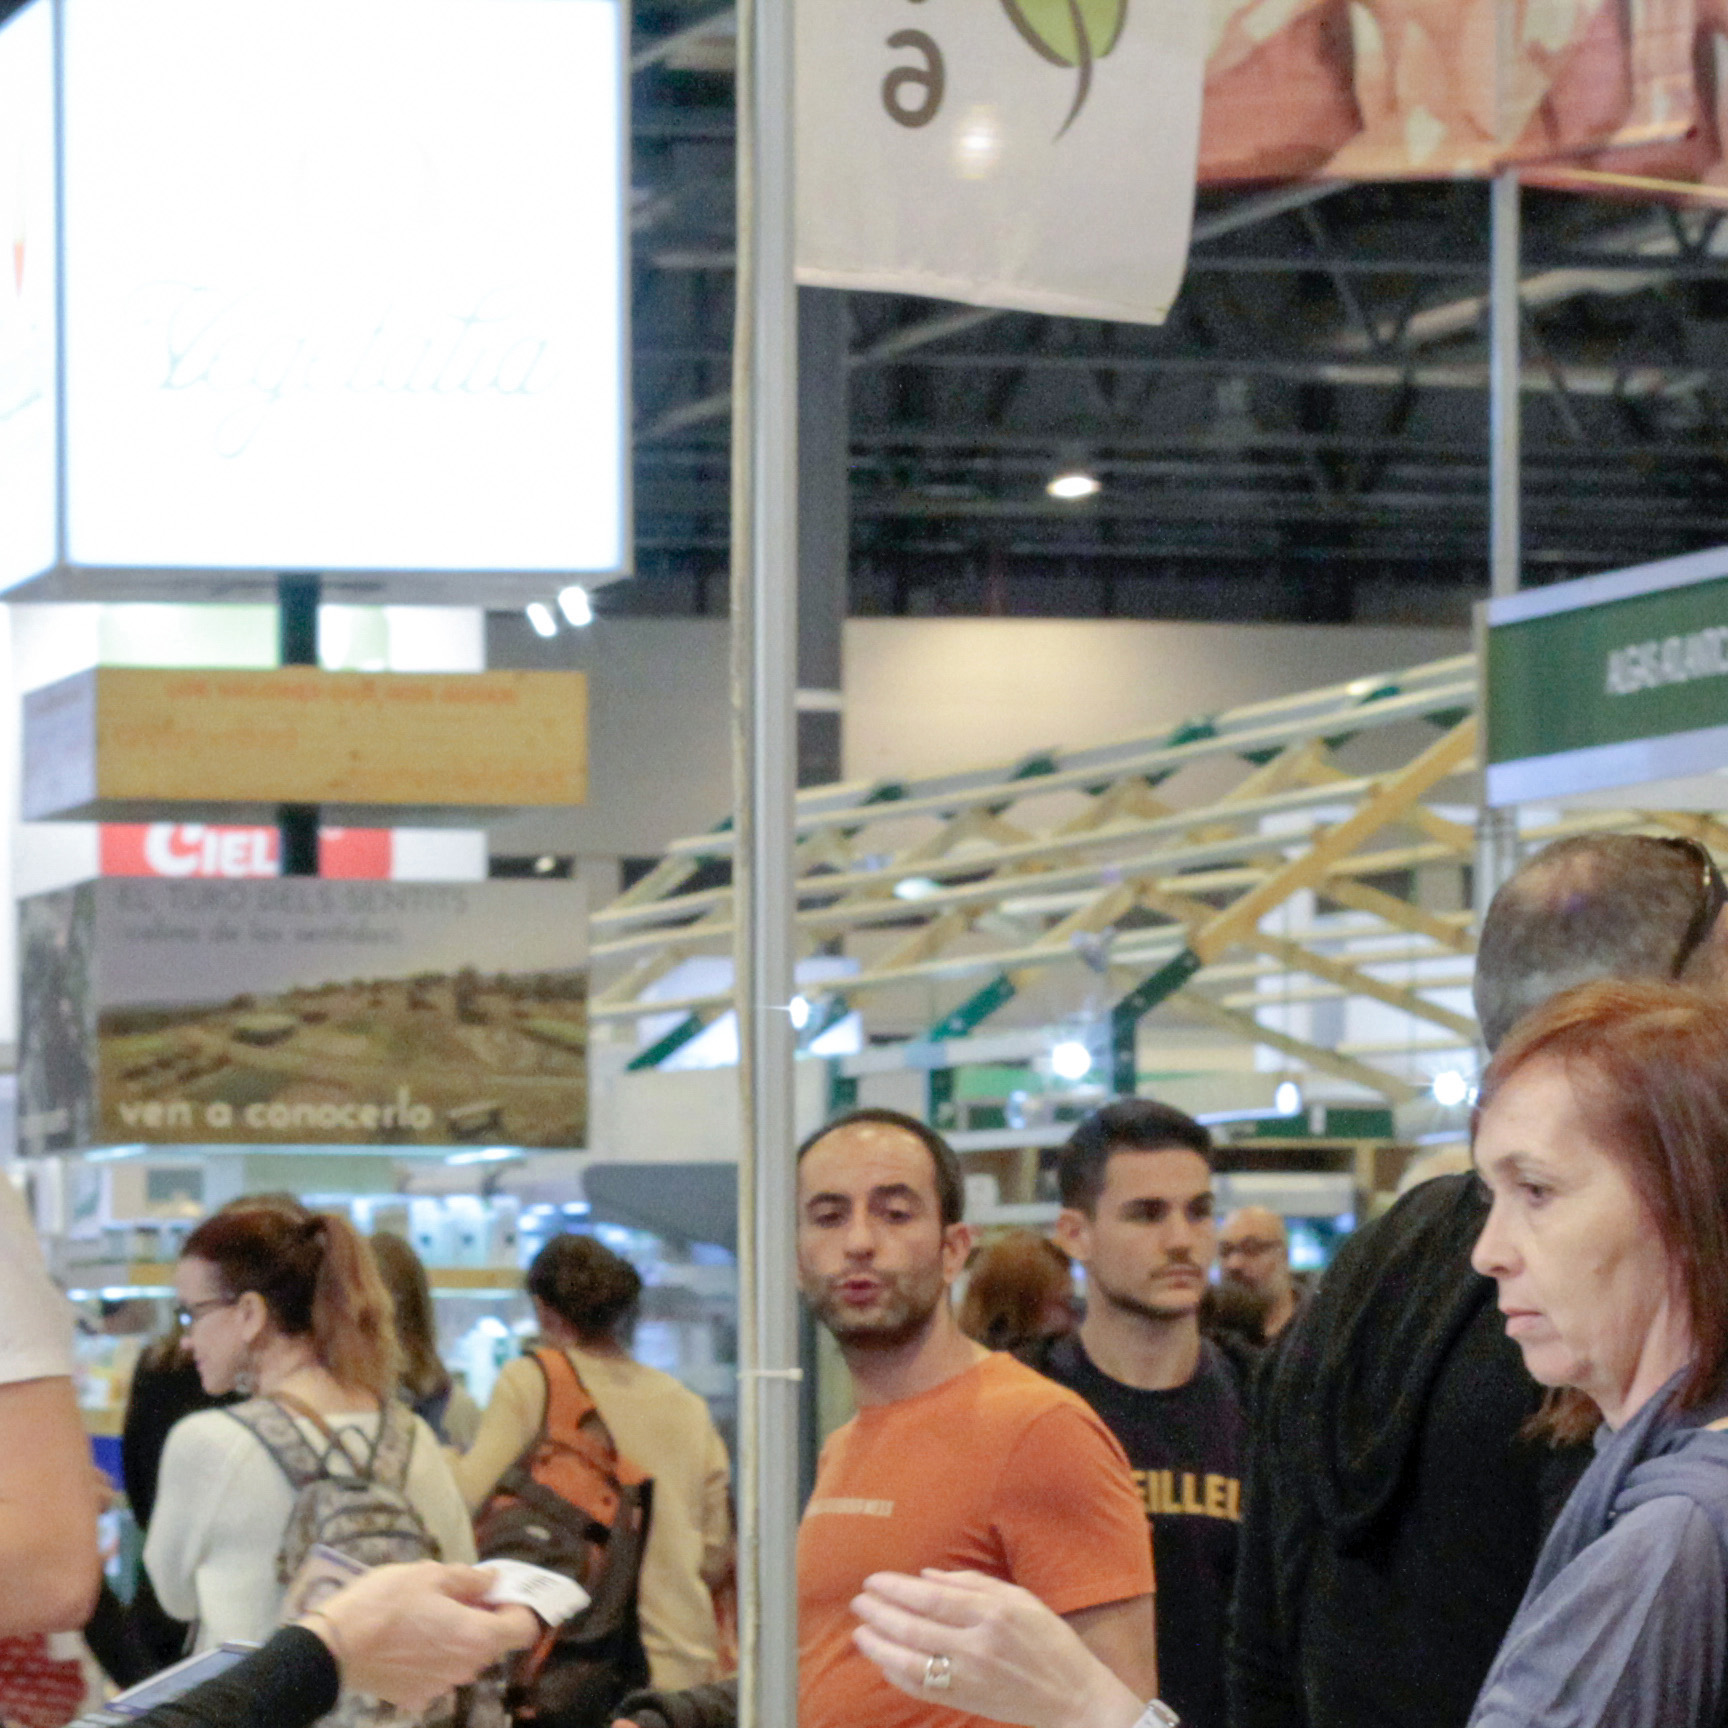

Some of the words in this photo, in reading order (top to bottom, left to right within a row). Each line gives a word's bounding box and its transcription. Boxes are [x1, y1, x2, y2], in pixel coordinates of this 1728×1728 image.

[119, 1100, 196, 1131] ven
[205, 1101, 234, 1130] a
[244, 1085, 434, 1131] conocerlo
[1131, 1467, 1242, 1522] EILLE
